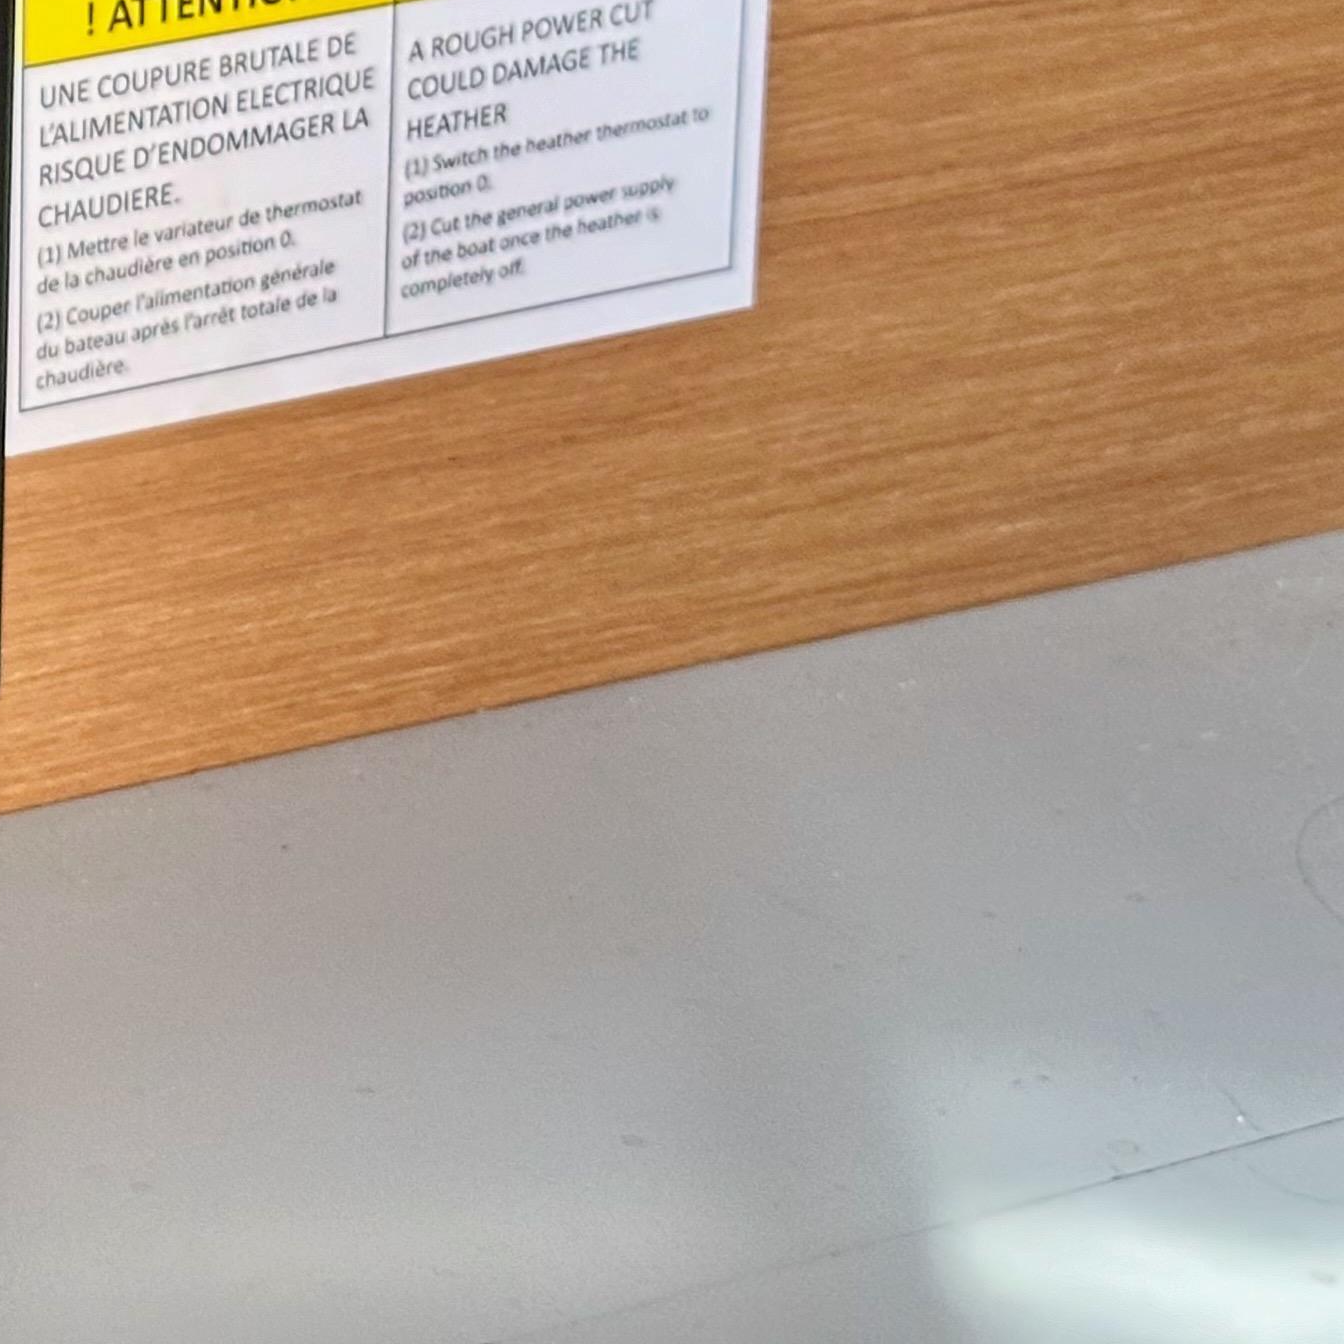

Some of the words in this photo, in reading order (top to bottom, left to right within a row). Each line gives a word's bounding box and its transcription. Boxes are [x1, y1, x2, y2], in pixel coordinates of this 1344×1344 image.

[408, 40, 424, 62] A
[431, 22, 513, 56] ROUGH
[521, 7, 602, 41] POWER
[40, 79, 89, 108] UNE
[97, 57, 210, 99] COUPURE
[220, 37, 318, 78] BRUTALE
[327, 32, 356, 55] DE
[237, 66, 375, 114] ELECTRIQUE
[408, 66, 485, 100] COULD
[492, 47, 590, 87] DAMAGE
[598, 37, 640, 65] THE
[39, 150, 125, 188] RISQUE
[343, 106, 368, 131] LA
[404, 157, 429, 180] (1)
[433, 146, 488, 172] Switch
[494, 141, 521, 160] the
[526, 127, 590, 153] heather
[596, 110, 688, 141] thermostat
[693, 107, 710, 122] to
[407, 103, 508, 141] HEATHER
[38, 182, 181, 228] CHAUDIERE.
[403, 181, 472, 209] position
[430, 216, 459, 235] Cut
[465, 210, 493, 228] the
[497, 197, 560, 226] general
[564, 186, 616, 210] power
[622, 174, 675, 202] supply
[37, 245, 61, 269] (1)
[67, 232, 127, 260] Mettre
[134, 226, 149, 247] le
[155, 216, 232, 243] variateur
[239, 209, 260, 227] de
[266, 188, 362, 222] thermostat
[402, 251, 421, 270] of
[424, 245, 452, 263] the
[457, 238, 495, 258] boat
[499, 231, 540, 250] once
[545, 223, 573, 241] the
[577, 209, 641, 234] heather
[37, 275, 59, 295] de
[65, 270, 80, 289] la
[85, 252, 173, 285] chaudière
[179, 250, 200, 267] en
[206, 234, 275, 266] position
[37, 310, 60, 334] (2)
[66, 300, 129, 327] Couper
[261, 256, 335, 290] générale
[401, 267, 494, 299] completely
[37, 341, 59, 361] du
[65, 329, 125, 354] bateau
[132, 311, 178, 342] après
[241, 294, 290, 319] totale
[296, 289, 317, 307] de
[323, 284, 337, 303] la
